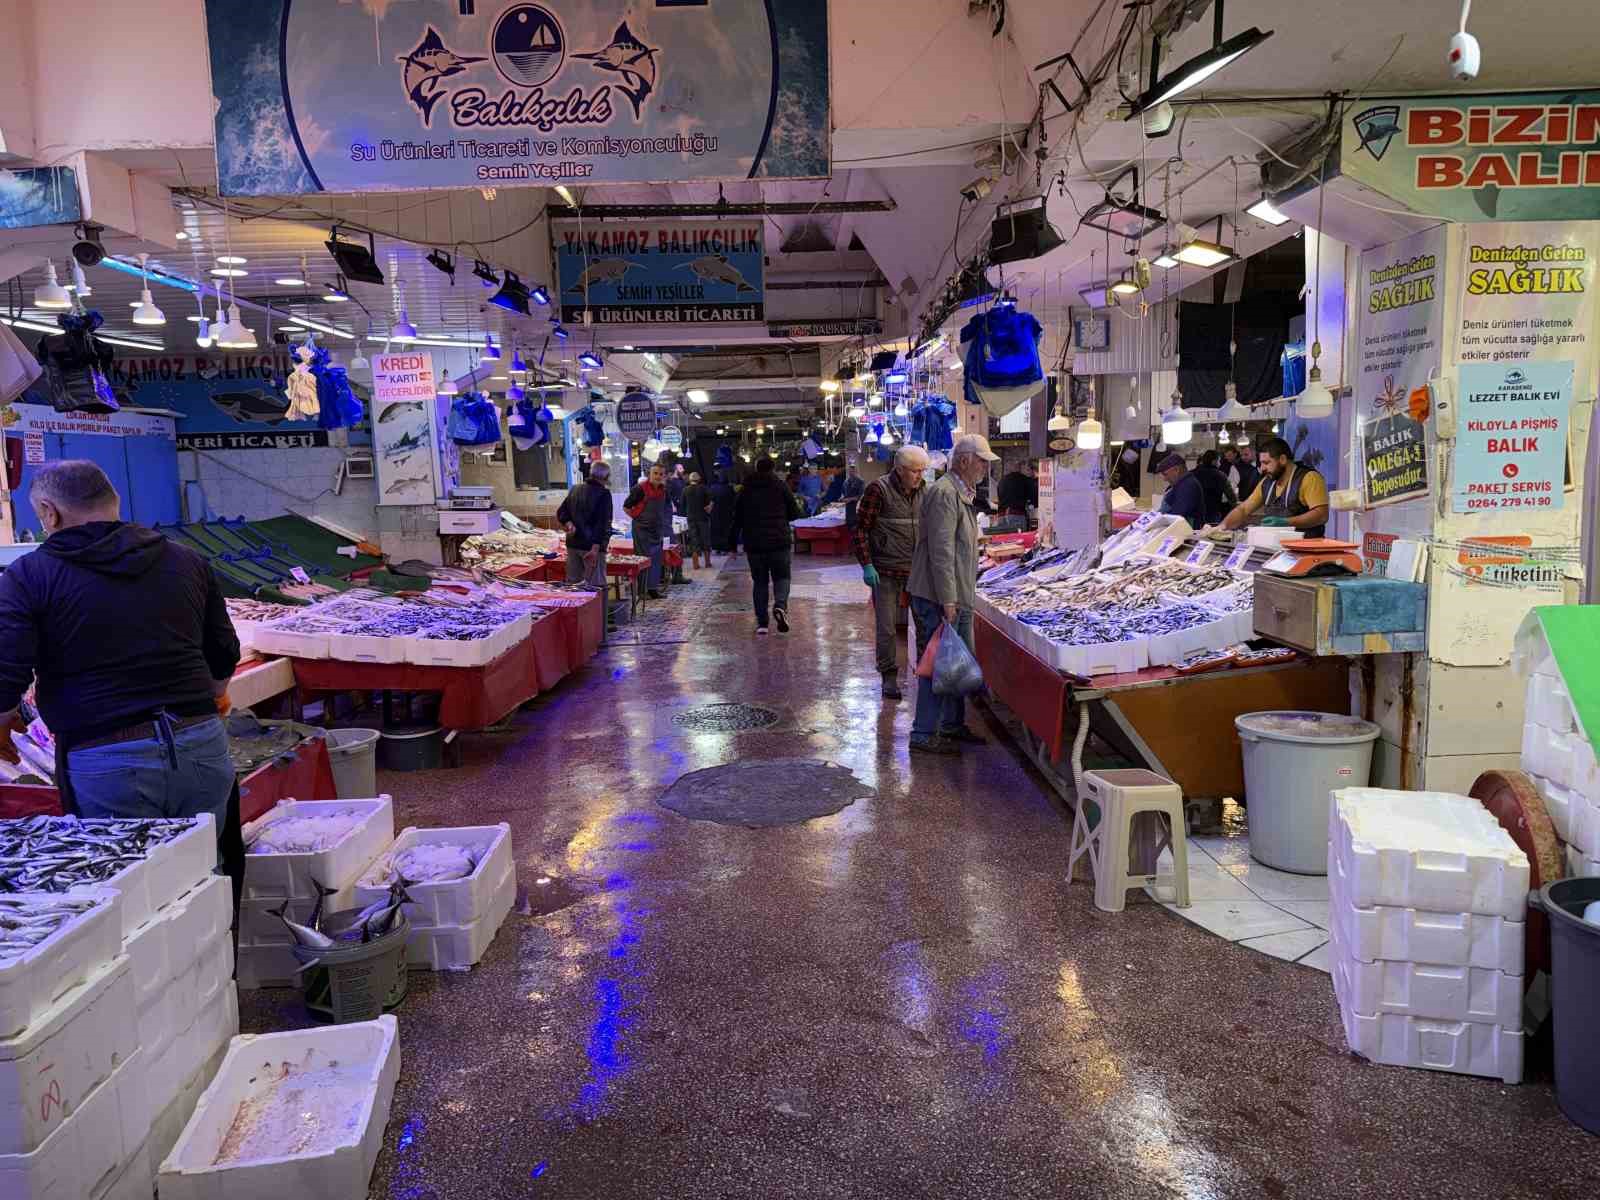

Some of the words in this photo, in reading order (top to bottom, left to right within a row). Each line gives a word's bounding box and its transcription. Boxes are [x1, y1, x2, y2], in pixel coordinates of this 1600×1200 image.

[451, 86, 612, 132] Balıkçılık
[351, 143, 376, 161] Su
[381, 138, 455, 160] Ürünleri
[458, 137, 530, 158] Ticareti
[534, 141, 557, 156] ve
[562, 133, 719, 157] Komisyonculuğu
[478, 164, 529, 180] Semih
[530, 162, 594, 180] Yeşiller
[563, 231, 649, 255] YAKAMOZ
[1471, 245, 1539, 262] Denizden
[1541, 245, 1585, 261] Gelen
[1468, 262, 1585, 294] SAĞLIK
[1368, 275, 1435, 313] SAĞLIK
[573, 311, 594, 322] S
[600, 307, 680, 323] ÜRÜNLERİ
[684, 305, 756, 321] TİCARETİ
[1463, 320, 1489, 329] Deniz
[1492, 320, 1528, 329] ürünleri
[1531, 319, 1574, 328] tüketmek
[1462, 336, 1480, 345] tüm
[1484, 336, 1518, 345] vücutta
[1520, 335, 1554, 346] sağlığa
[1556, 334, 1585, 345] yararlı
[380, 353, 424, 371] KREDİ
[1462, 351, 1491, 360] etkiler
[1493, 351, 1531, 361] gösterir
[389, 374, 418, 384] KARTI
[1469, 393, 1508, 402] LEZZET
[1510, 392, 1541, 401] BALIK
[1543, 390, 1561, 401] EVİ
[1468, 419, 1518, 431] KİLOYLA
[1521, 416, 1558, 431] PİŞMİŞ
[228, 432, 315, 450] TİCARETİ
[1375, 427, 1413, 452] BALIK
[1487, 437, 1539, 453] BALIK
[1368, 443, 1422, 474] OMEGA-3
[1468, 483, 1508, 494] PAKET
[1511, 480, 1552, 493] SERVİS
[1468, 499, 1498, 509] 0264
[1501, 497, 1521, 507] 279
